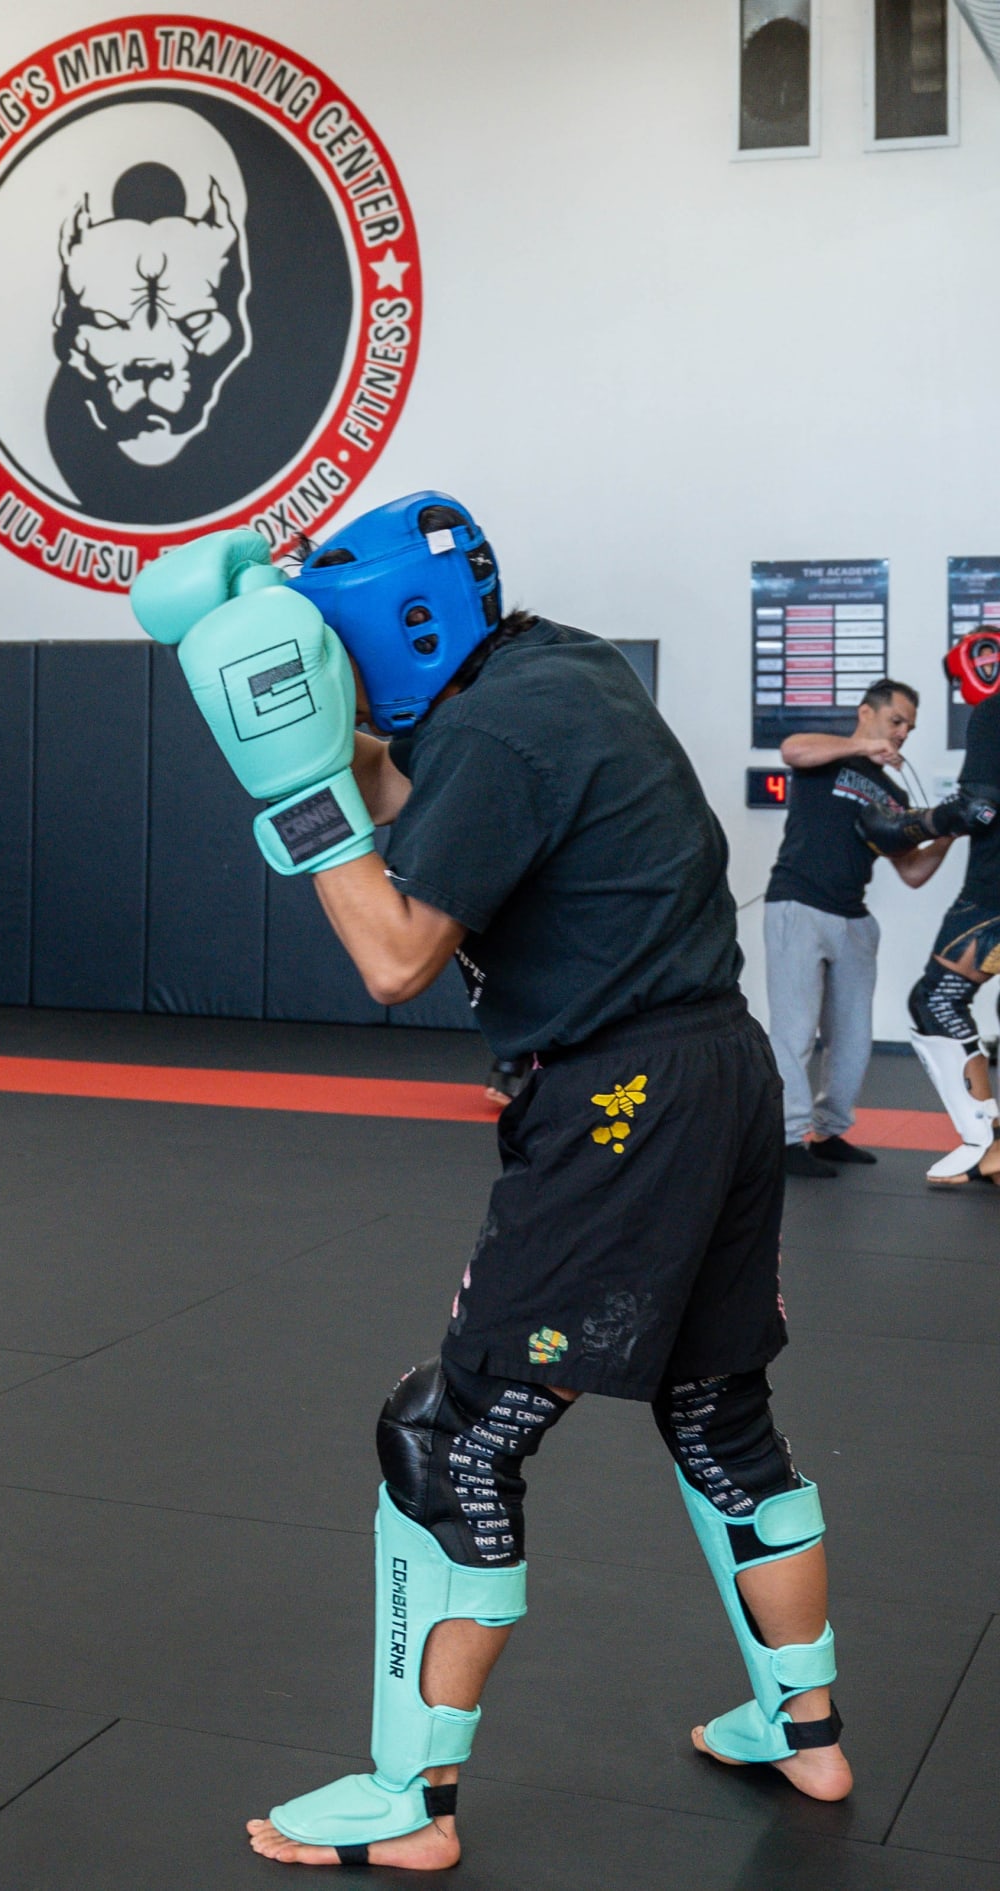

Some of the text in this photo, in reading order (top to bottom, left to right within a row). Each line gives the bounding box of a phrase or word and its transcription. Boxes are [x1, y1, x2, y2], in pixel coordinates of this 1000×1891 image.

[59, 31, 146, 90] MMA
[160, 31, 320, 119] TRAINING
[312, 107, 401, 244] CENTER
[345, 300, 409, 447] FITNESS
[803, 567, 879, 577] THE ACADEMY
[766, 776, 785, 802] 4
[389, 1557, 407, 1680] COMBATCRNR
